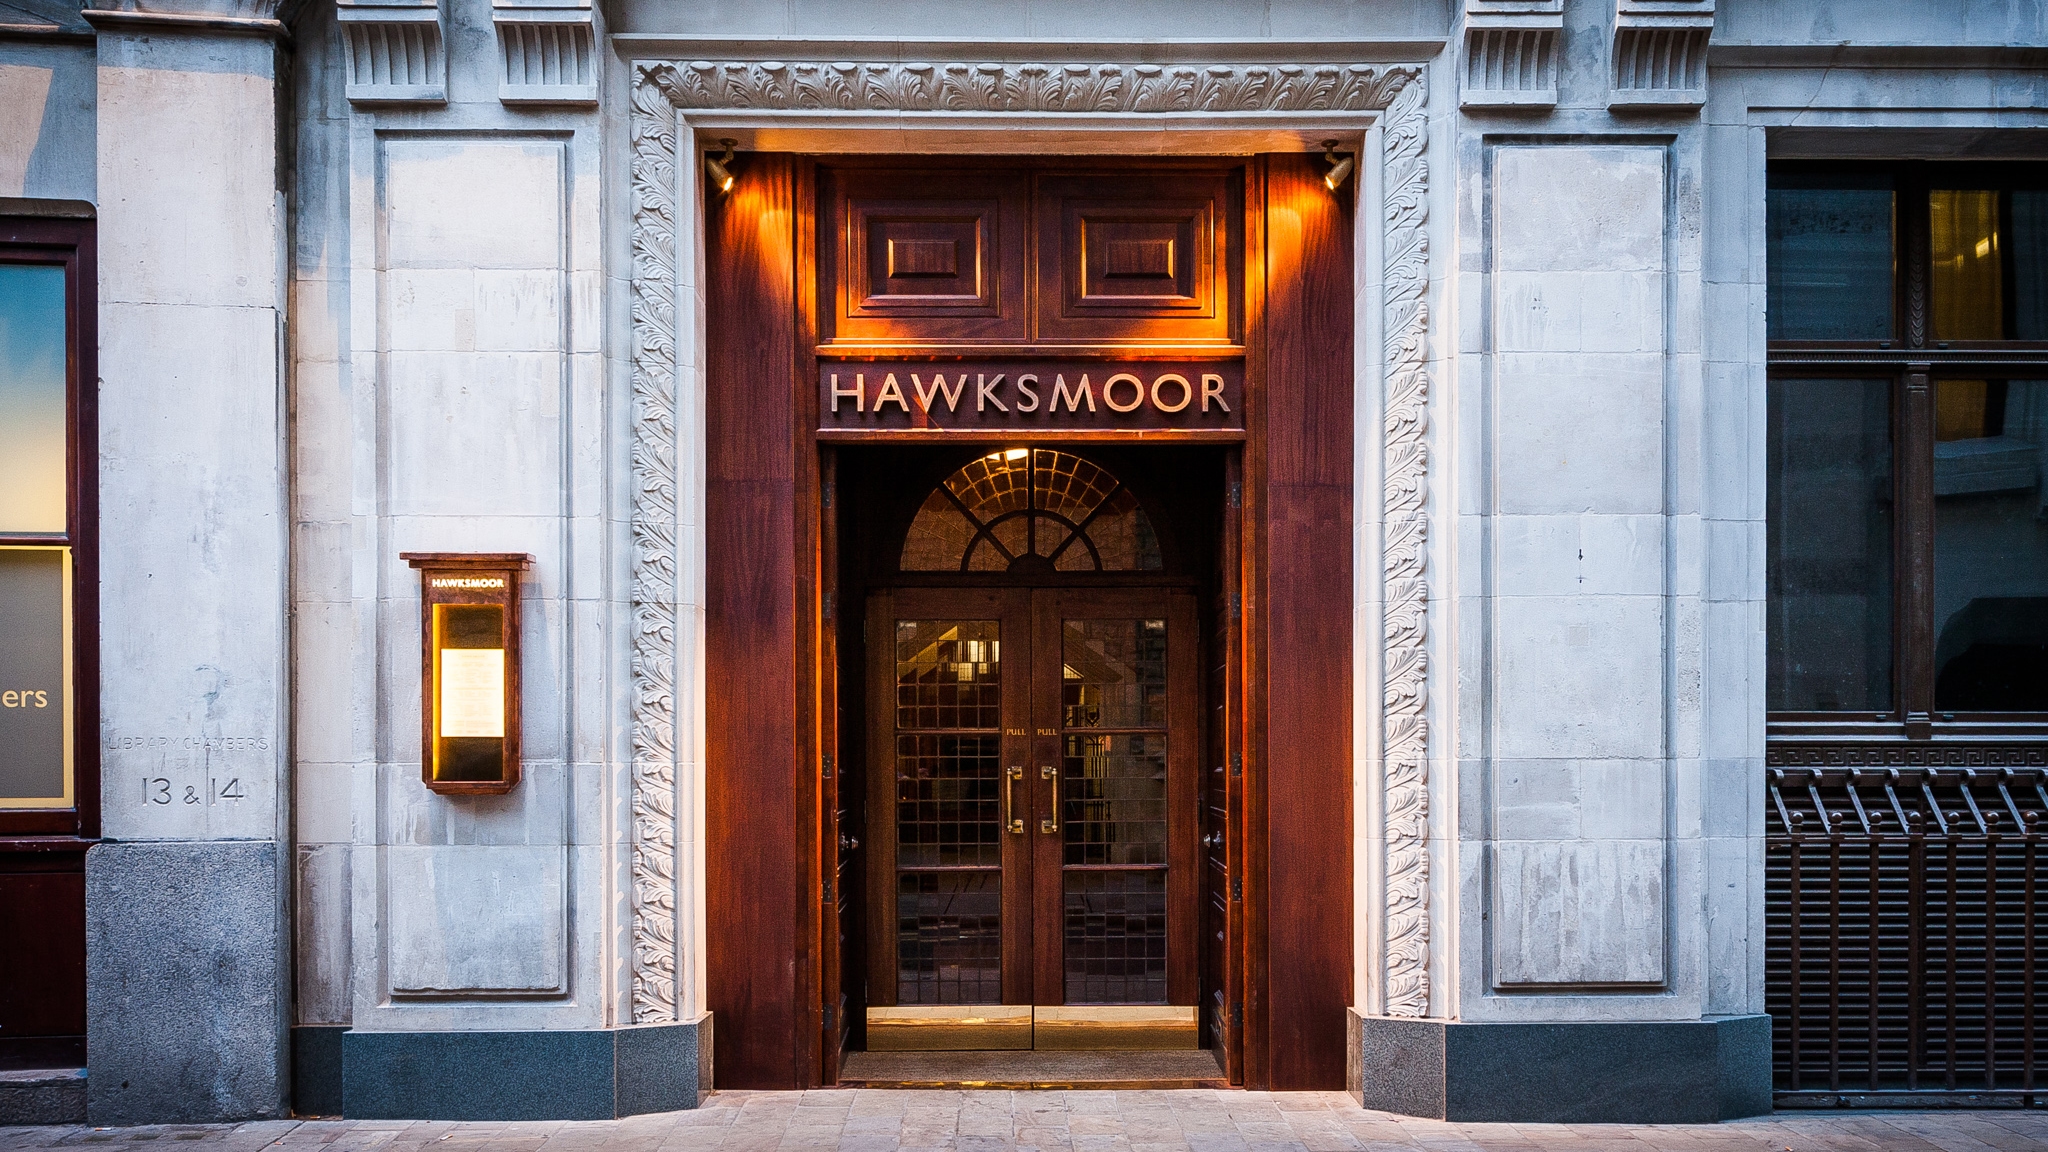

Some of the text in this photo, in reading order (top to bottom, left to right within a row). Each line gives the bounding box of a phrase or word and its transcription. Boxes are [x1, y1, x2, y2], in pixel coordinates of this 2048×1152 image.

[830, 373, 1231, 413] HAWKSMOOR
[432, 578, 504, 588] HAWKSMOOR
[2, 690, 48, 708] ers
[1006, 728, 1026, 736] PULL
[1037, 728, 1057, 736] PULL
[108, 736, 269, 750] LIBRARY CHAMBERS
[142, 778, 244, 806] 13 & 14
